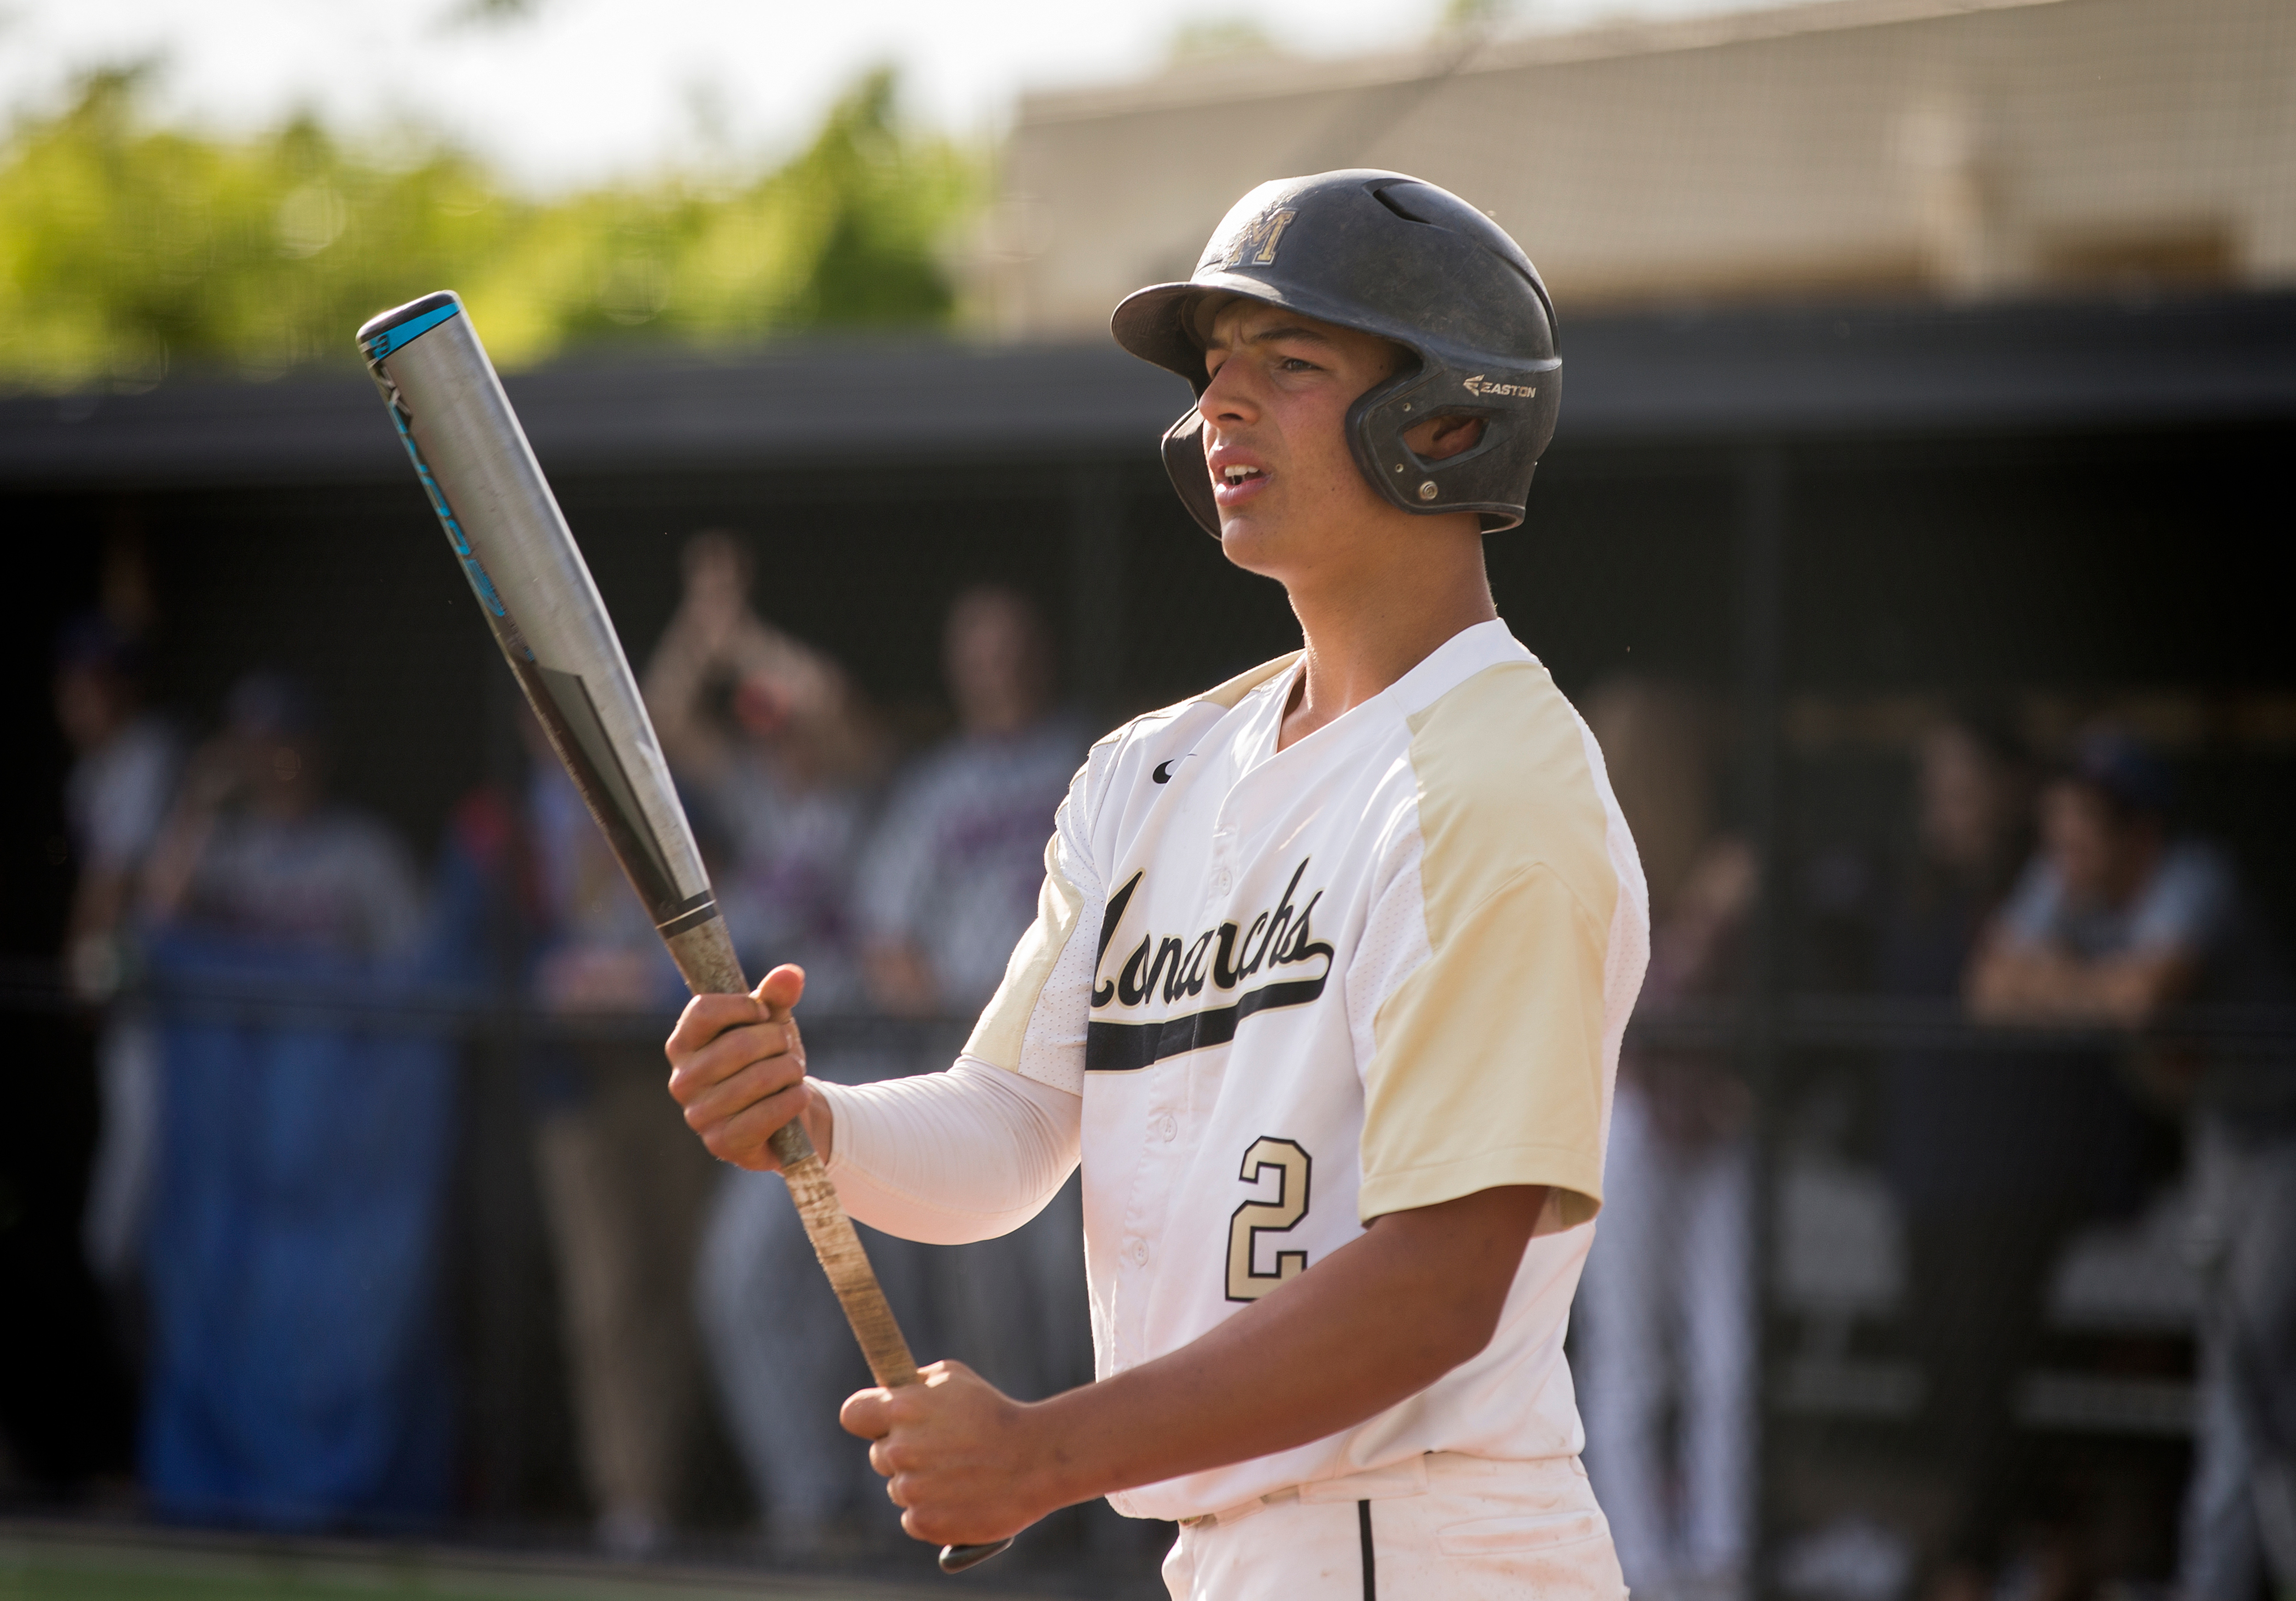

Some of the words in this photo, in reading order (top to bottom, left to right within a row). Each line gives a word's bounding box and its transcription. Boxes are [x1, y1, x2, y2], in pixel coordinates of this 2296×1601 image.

[1221, 208, 1299, 266] M
[1480, 381, 1536, 398] EASTON
[1225, 1135, 1312, 1302] 2
